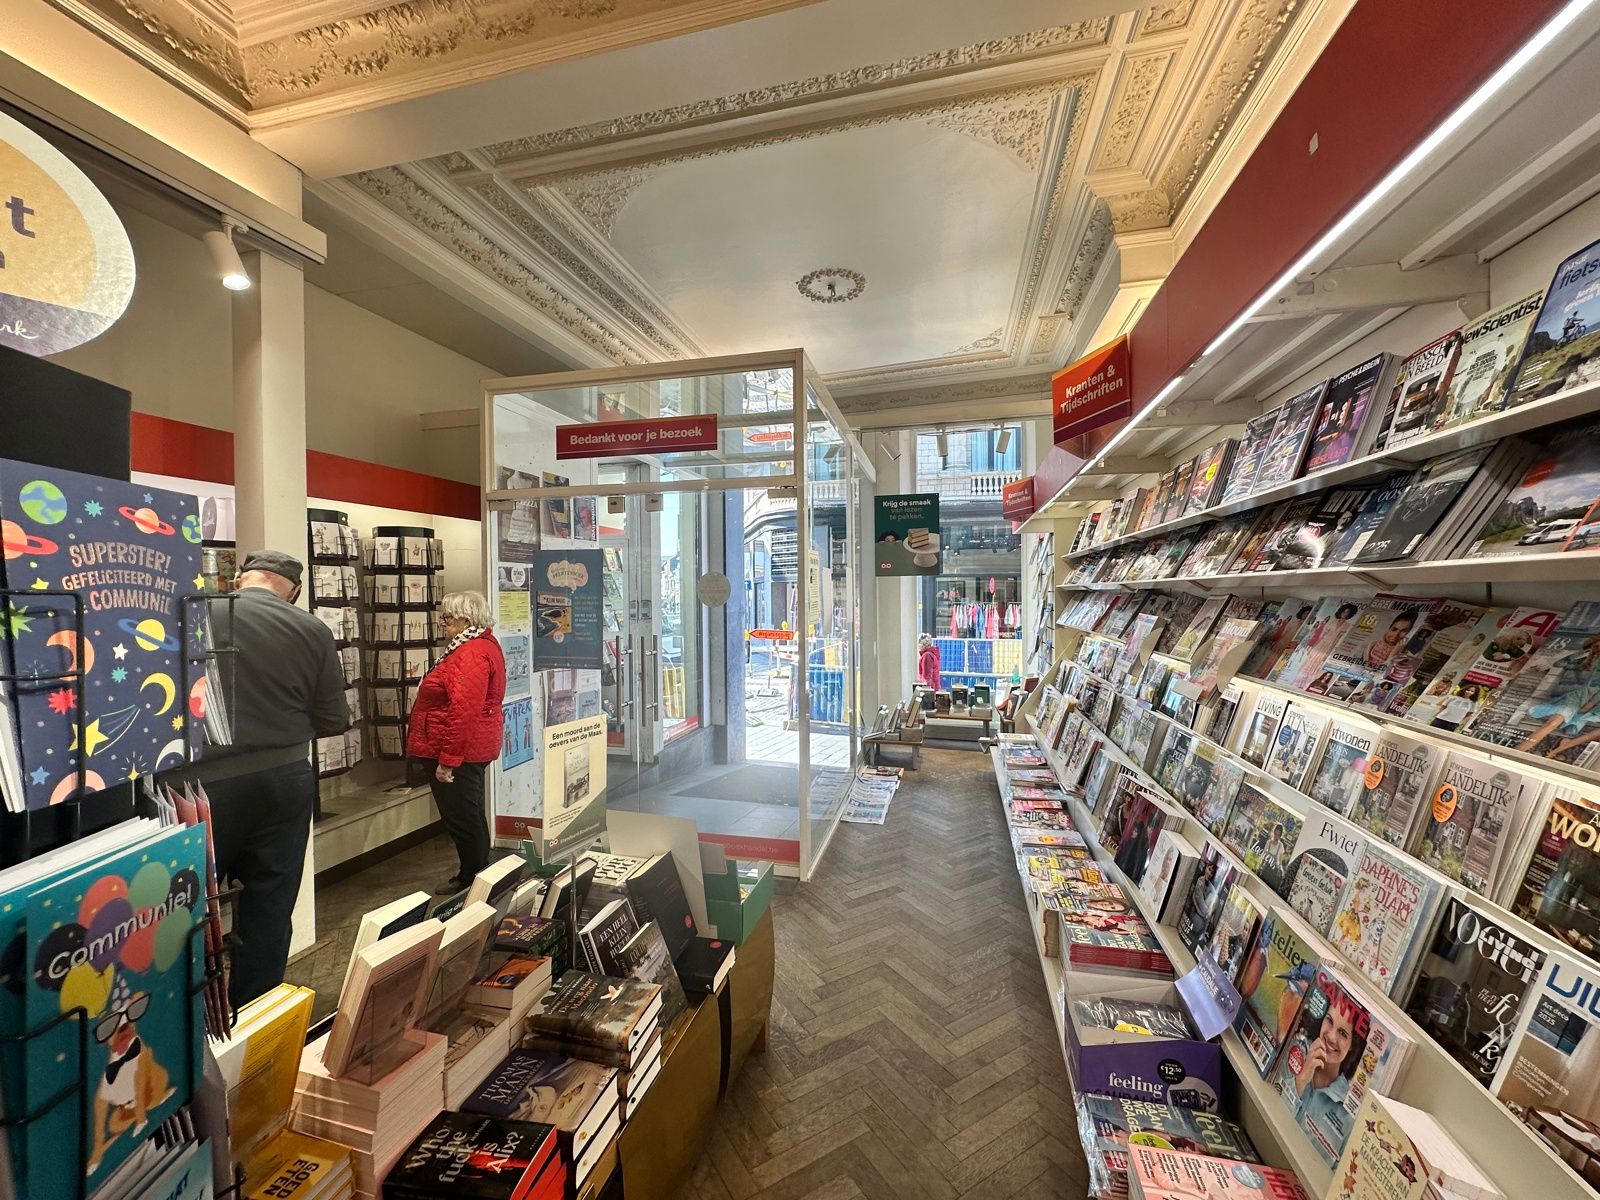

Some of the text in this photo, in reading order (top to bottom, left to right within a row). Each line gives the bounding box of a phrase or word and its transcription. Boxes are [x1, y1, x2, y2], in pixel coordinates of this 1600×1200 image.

[1059, 377, 1124, 414] Tijdschriften
[1066, 364, 1116, 398] Kranten &
[570, 426, 702, 445] Bedankt voor je bezoek
[69, 541, 171, 574] SUPERSTER!
[154, 578, 178, 595] MET
[1257, 700, 1282, 717] LIVING
[549, 738, 569, 749] oevers
[570, 735, 580, 743] van
[552, 732, 564, 741] Een
[564, 726, 582, 737] moord
[583, 725, 593, 733] aan
[1331, 726, 1371, 751] vtwonen
[1375, 744, 1427, 774] LANDELIJK
[1444, 769, 1508, 807] LANDELIJK
[1320, 821, 1359, 856] Fwiet
[1361, 855, 1420, 904] DAPHNE'S
[1375, 887, 1413, 922] DIARY
[49, 883, 193, 979] Communie!
[599, 913, 629, 943] EEN HEEL
[608, 927, 628, 948] KLEIN
[1266, 919, 1308, 968] Atelier
[1538, 1012, 1556, 1026] 2025
[1542, 1001, 1552, 1012] Art
[1553, 1007, 1569, 1021] deco
[480, 1055, 527, 1099] THOMAS
[490, 1060, 538, 1101] MANN
[1108, 1072, 1163, 1099] feeling
[1132, 1100, 1147, 1117] WE
[1143, 1101, 1165, 1132] GAAN
[1155, 1103, 1173, 1121] DIT
[405, 1128, 451, 1169] Who
[436, 1131, 467, 1160] the
[479, 1142, 498, 1157] is
[486, 1131, 525, 1174] Alix?
[262, 1158, 308, 1196] ETEN
[439, 1143, 479, 1183] fuck
[1361, 1131, 1371, 1147] DE
[1369, 1143, 1396, 1178] KRACHT
[1395, 1175, 1410, 1199] VAN
[276, 1160, 319, 1199] GOED
